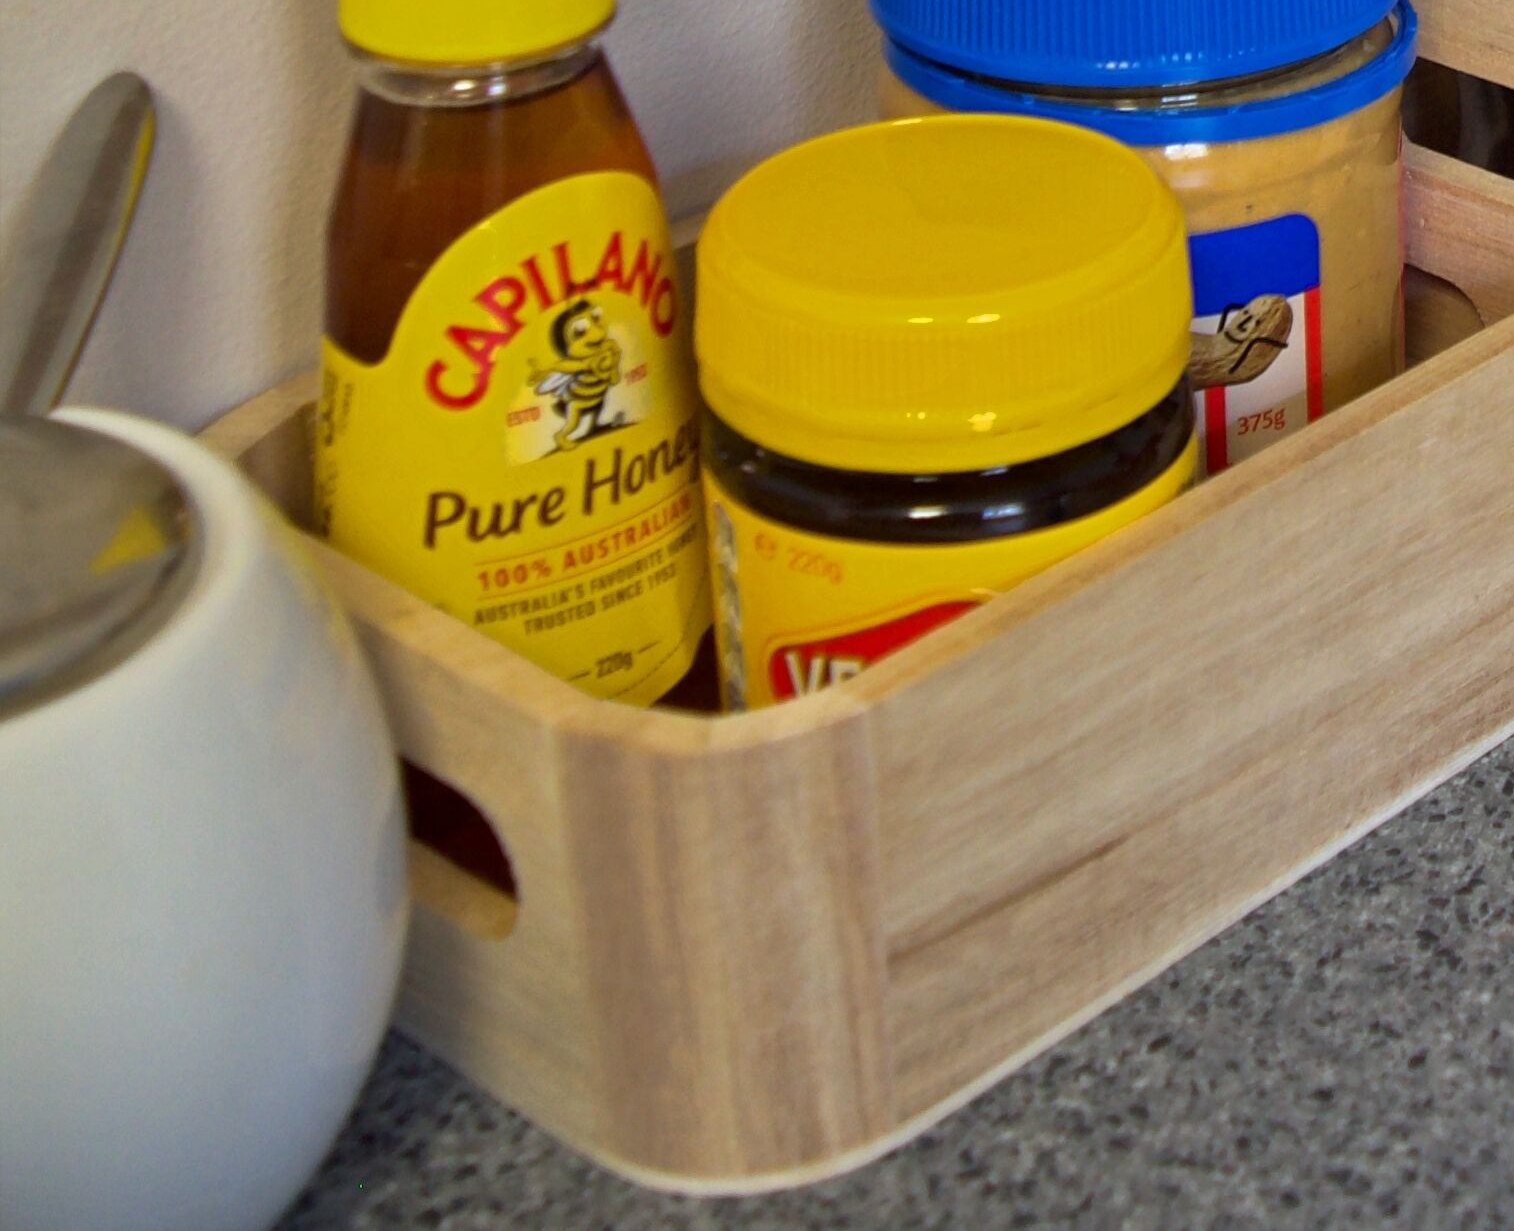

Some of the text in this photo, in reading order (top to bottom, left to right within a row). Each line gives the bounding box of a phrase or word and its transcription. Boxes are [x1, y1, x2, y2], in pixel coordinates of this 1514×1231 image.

[424, 231, 676, 411] CAPILANO
[1237, 408, 1286, 437] 375g
[423, 485, 566, 550] Pure
[478, 492, 692, 592] 100% AUSTRALIAN
[524, 600, 596, 635] TRUSTED
[601, 580, 644, 611] SINCE
